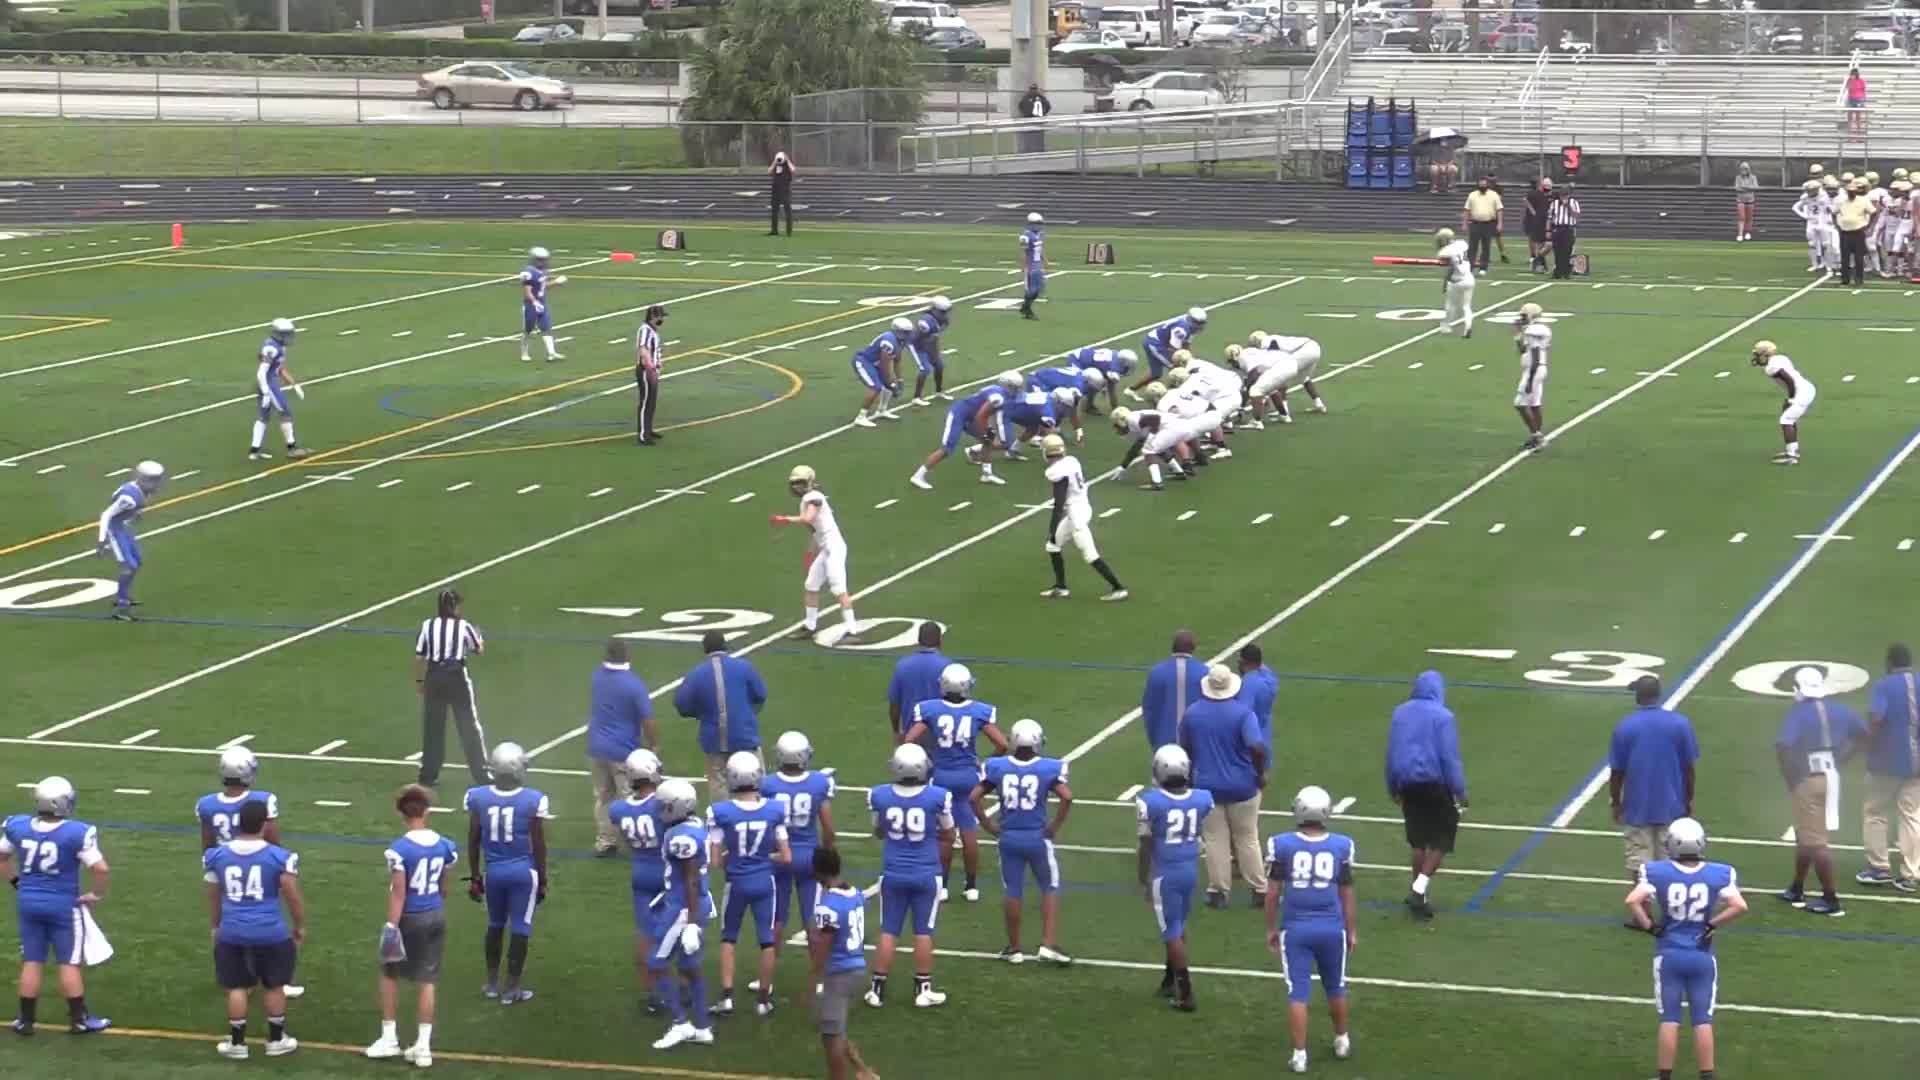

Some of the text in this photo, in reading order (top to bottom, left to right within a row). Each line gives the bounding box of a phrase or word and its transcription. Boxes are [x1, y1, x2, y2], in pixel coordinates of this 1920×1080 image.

[1562, 148, 1580, 169] 3
[937, 715, 972, 748] 34
[1001, 774, 1039, 810] 63
[213, 813, 241, 843] 3
[487, 806, 514, 843] 11
[734, 821, 768, 857] 17
[886, 807, 926, 841] 39
[1164, 808, 1198, 844] 21
[21, 839, 60, 873] 72
[1292, 851, 1335, 888] 89
[224, 865, 264, 902] 64
[409, 855, 445, 896] 42
[1667, 883, 1709, 922] 82
